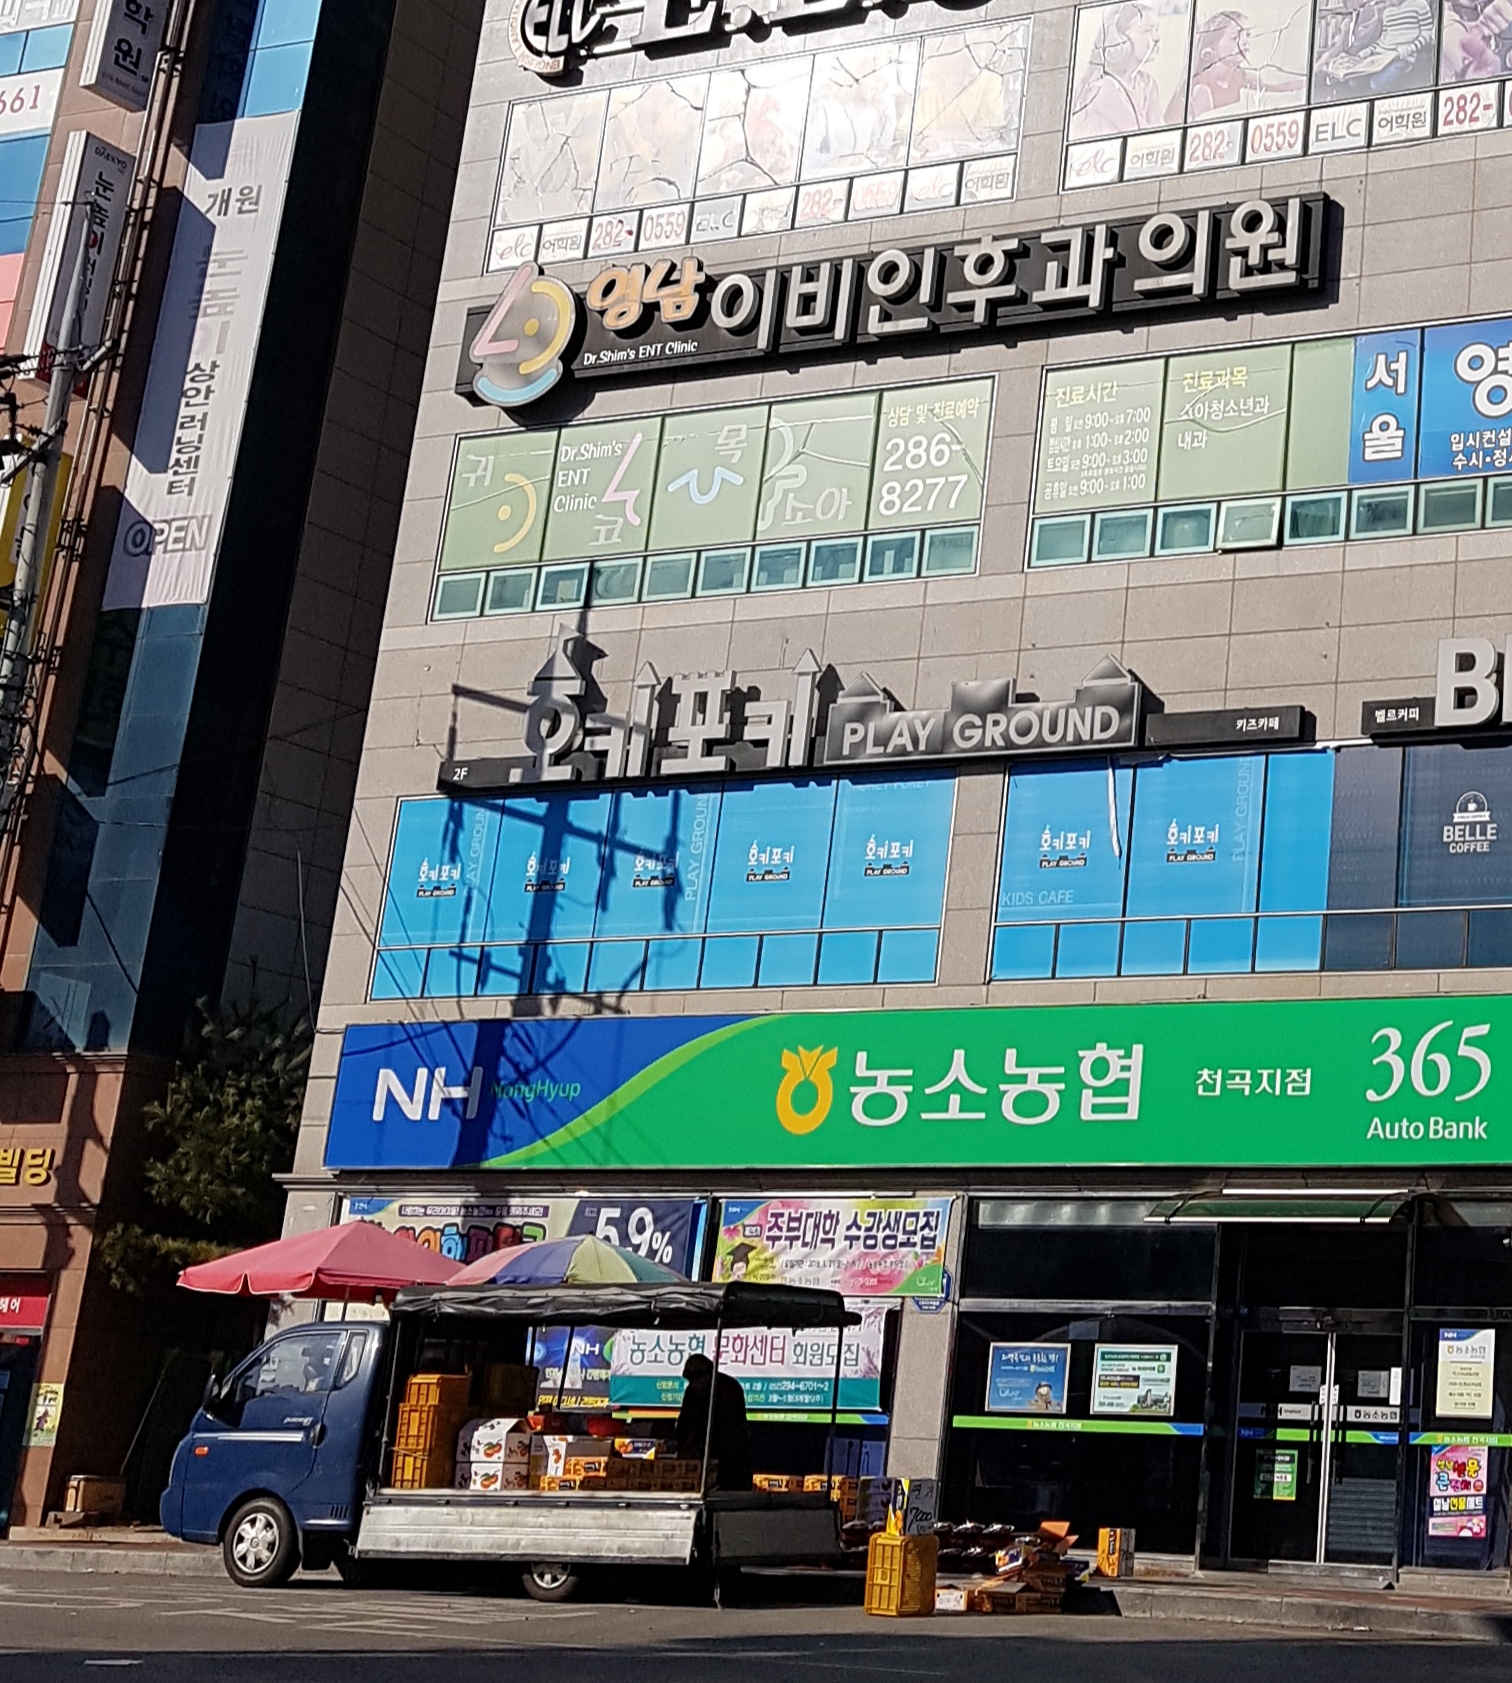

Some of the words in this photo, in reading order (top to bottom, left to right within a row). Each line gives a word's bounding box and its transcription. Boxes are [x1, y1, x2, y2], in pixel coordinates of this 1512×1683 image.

[1314, 119, 1362, 145] ELC
[1376, 110, 1428, 134] 어학원
[1250, 120, 1300, 153] 0559
[1128, 145, 1177, 172] 어학원
[965, 171, 1011, 193] 어학원
[205, 185, 263, 217] 개원
[644, 211, 685, 243] 0559
[586, 256, 705, 330] 영남
[638, 343, 663, 359] ENT
[665, 338, 698, 355] Clinic
[1182, 366, 1249, 393] 진료과목
[1055, 380, 1118, 408] 진료시간
[1362, 350, 1408, 462] 서울
[887, 404, 912, 427] 상담
[715, 424, 749, 464] 목
[1177, 431, 1208, 450] 내과
[461, 455, 494, 488] 귀
[557, 468, 591, 487] ENT
[553, 493, 597, 513] Clinic
[878, 475, 969, 515] 8277
[124, 516, 210, 556] OPEN
[590, 515, 623, 546] 코
[841, 716, 937, 756] PLAY
[952, 704, 1121, 749] GROUND
[1234, 715, 1280, 733] 키즈카페
[453, 767, 469, 781] 2F
[1443, 824, 1497, 842] BELLE
[1449, 842, 1490, 854] COFFEE
[1002, 891, 1034, 905] KIDS
[1038, 890, 1074, 904] CAFE
[1365, 1020, 1492, 1102] 365
[372, 1066, 484, 1121] NH
[850, 1042, 1144, 1126] 농소농협
[1195, 1068, 1312, 1097] 천곡지점
[1366, 1117, 1424, 1140] Auto
[1428, 1116, 1488, 1140] Bank
[765, 1210, 840, 1250] 주부대학
[844, 1208, 942, 1251] 수강생모집
